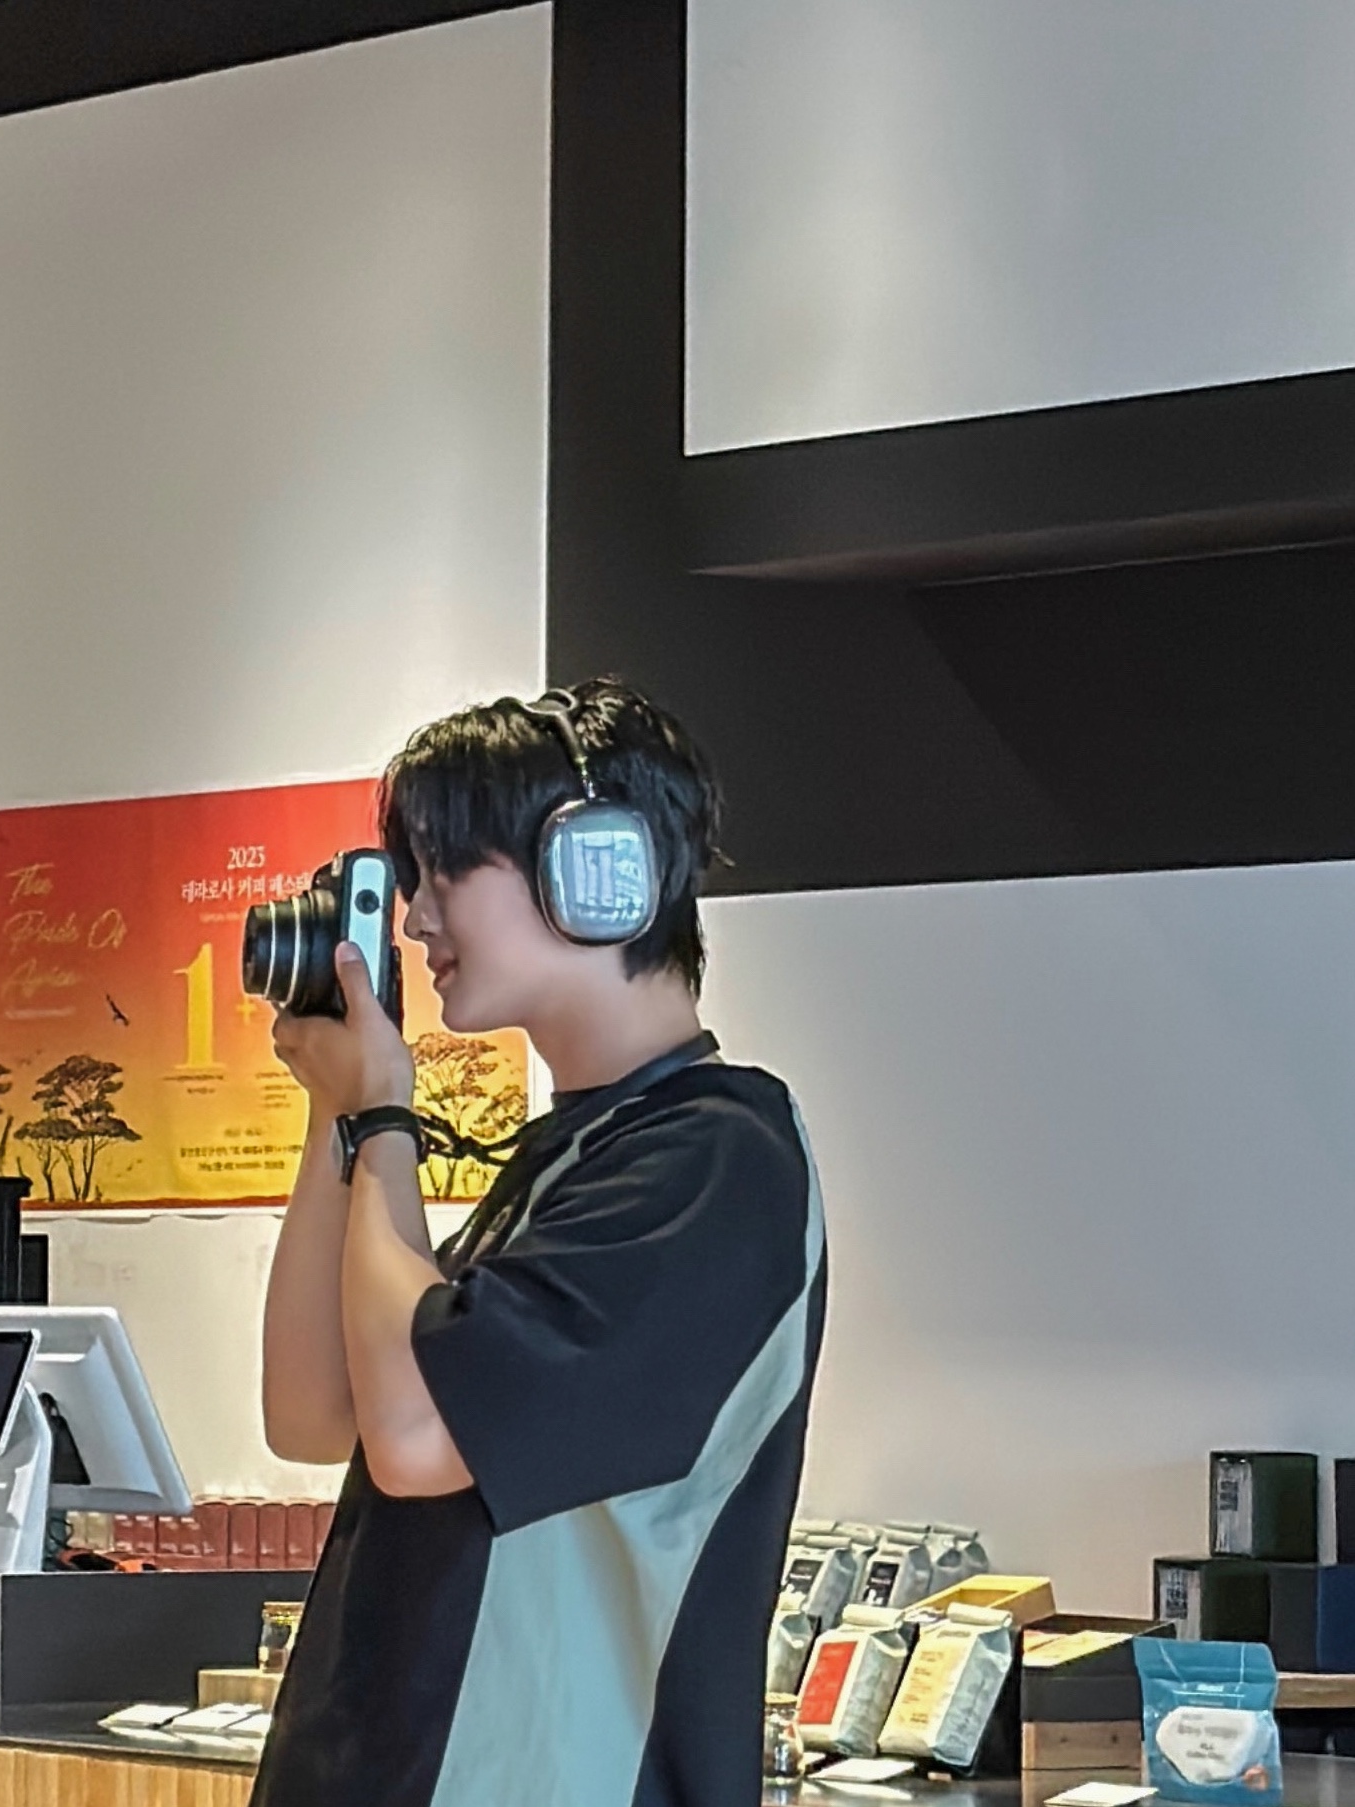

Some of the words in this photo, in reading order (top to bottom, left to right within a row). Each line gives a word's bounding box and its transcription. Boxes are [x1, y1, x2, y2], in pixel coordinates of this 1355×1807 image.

[227, 846, 266, 870] 2023
[181, 876, 235, 903] 테라로사
[237, 874, 267, 900] 커피
